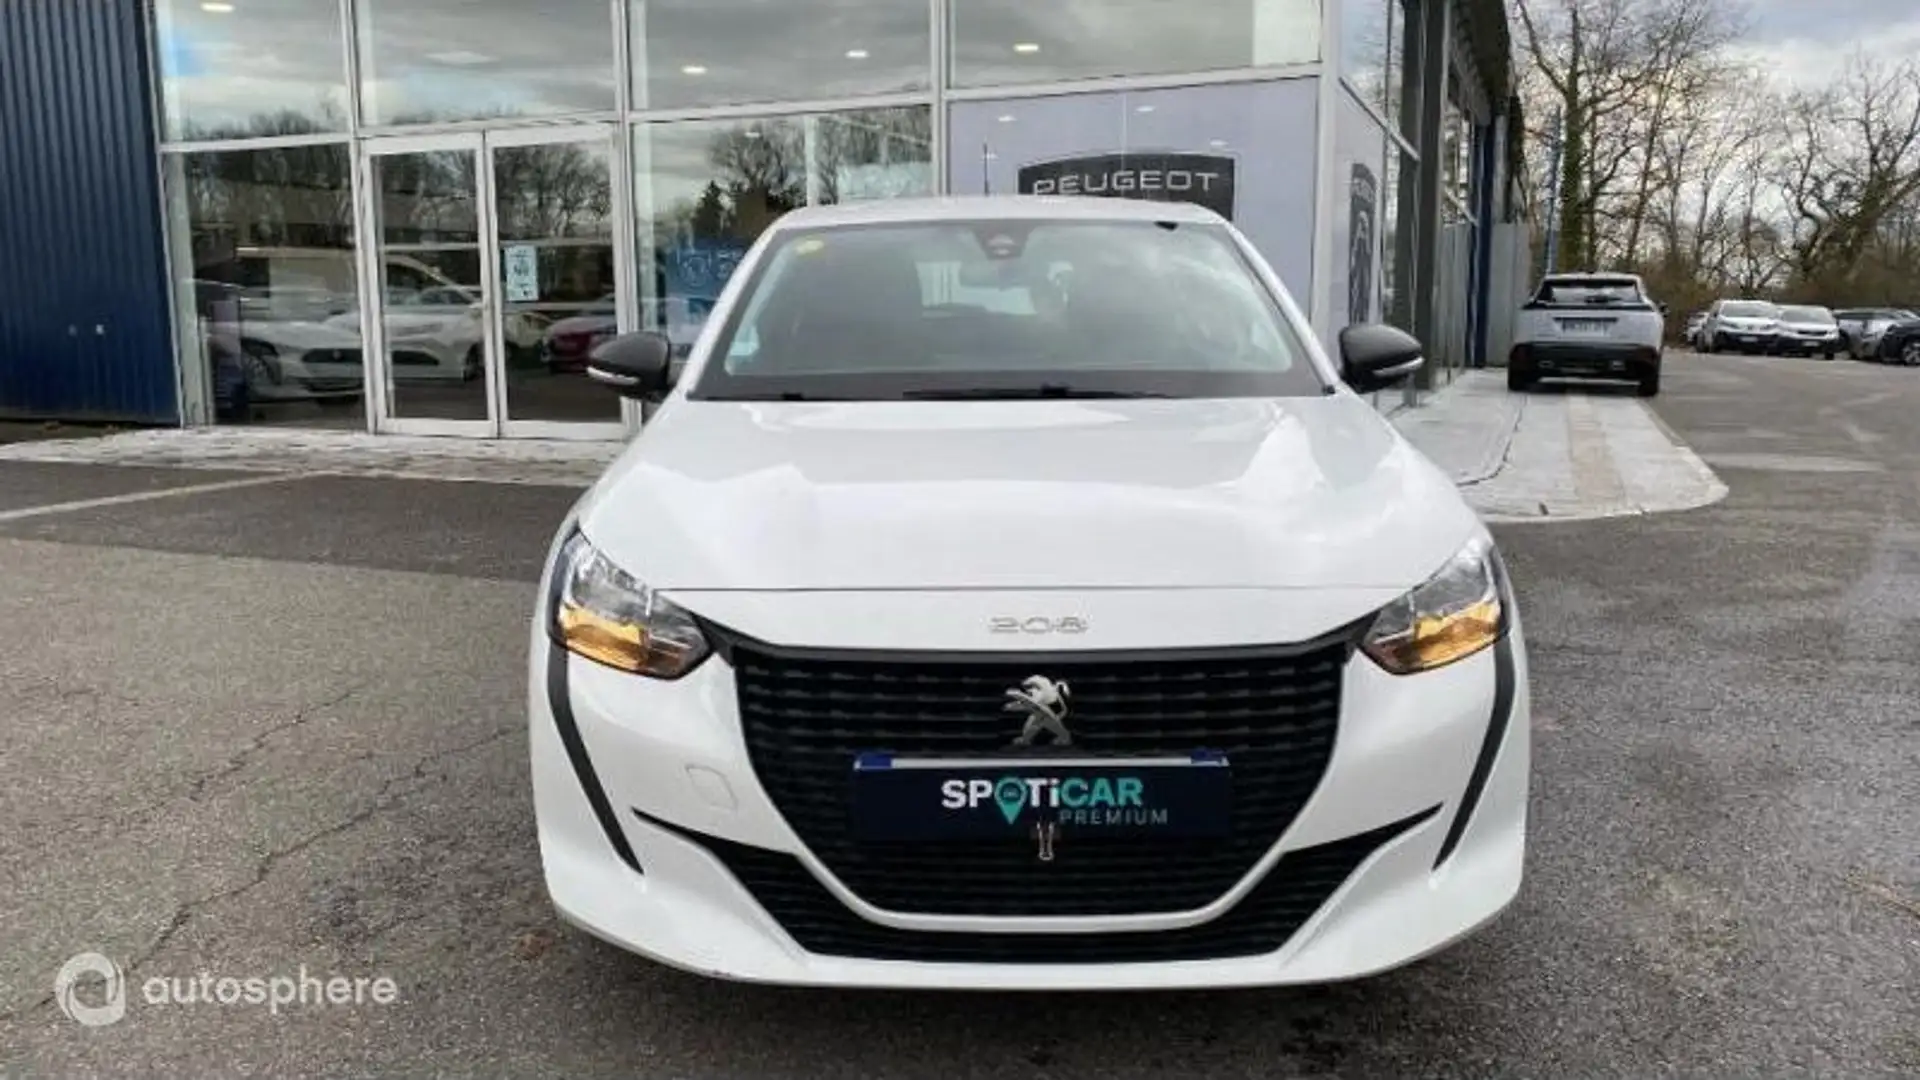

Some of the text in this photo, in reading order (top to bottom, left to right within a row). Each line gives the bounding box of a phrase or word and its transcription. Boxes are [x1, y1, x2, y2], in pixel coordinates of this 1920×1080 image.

[1032, 169, 1220, 196] PEUGEOT
[988, 615, 1088, 634] 208
[1059, 808, 1169, 825] PREMIUM
